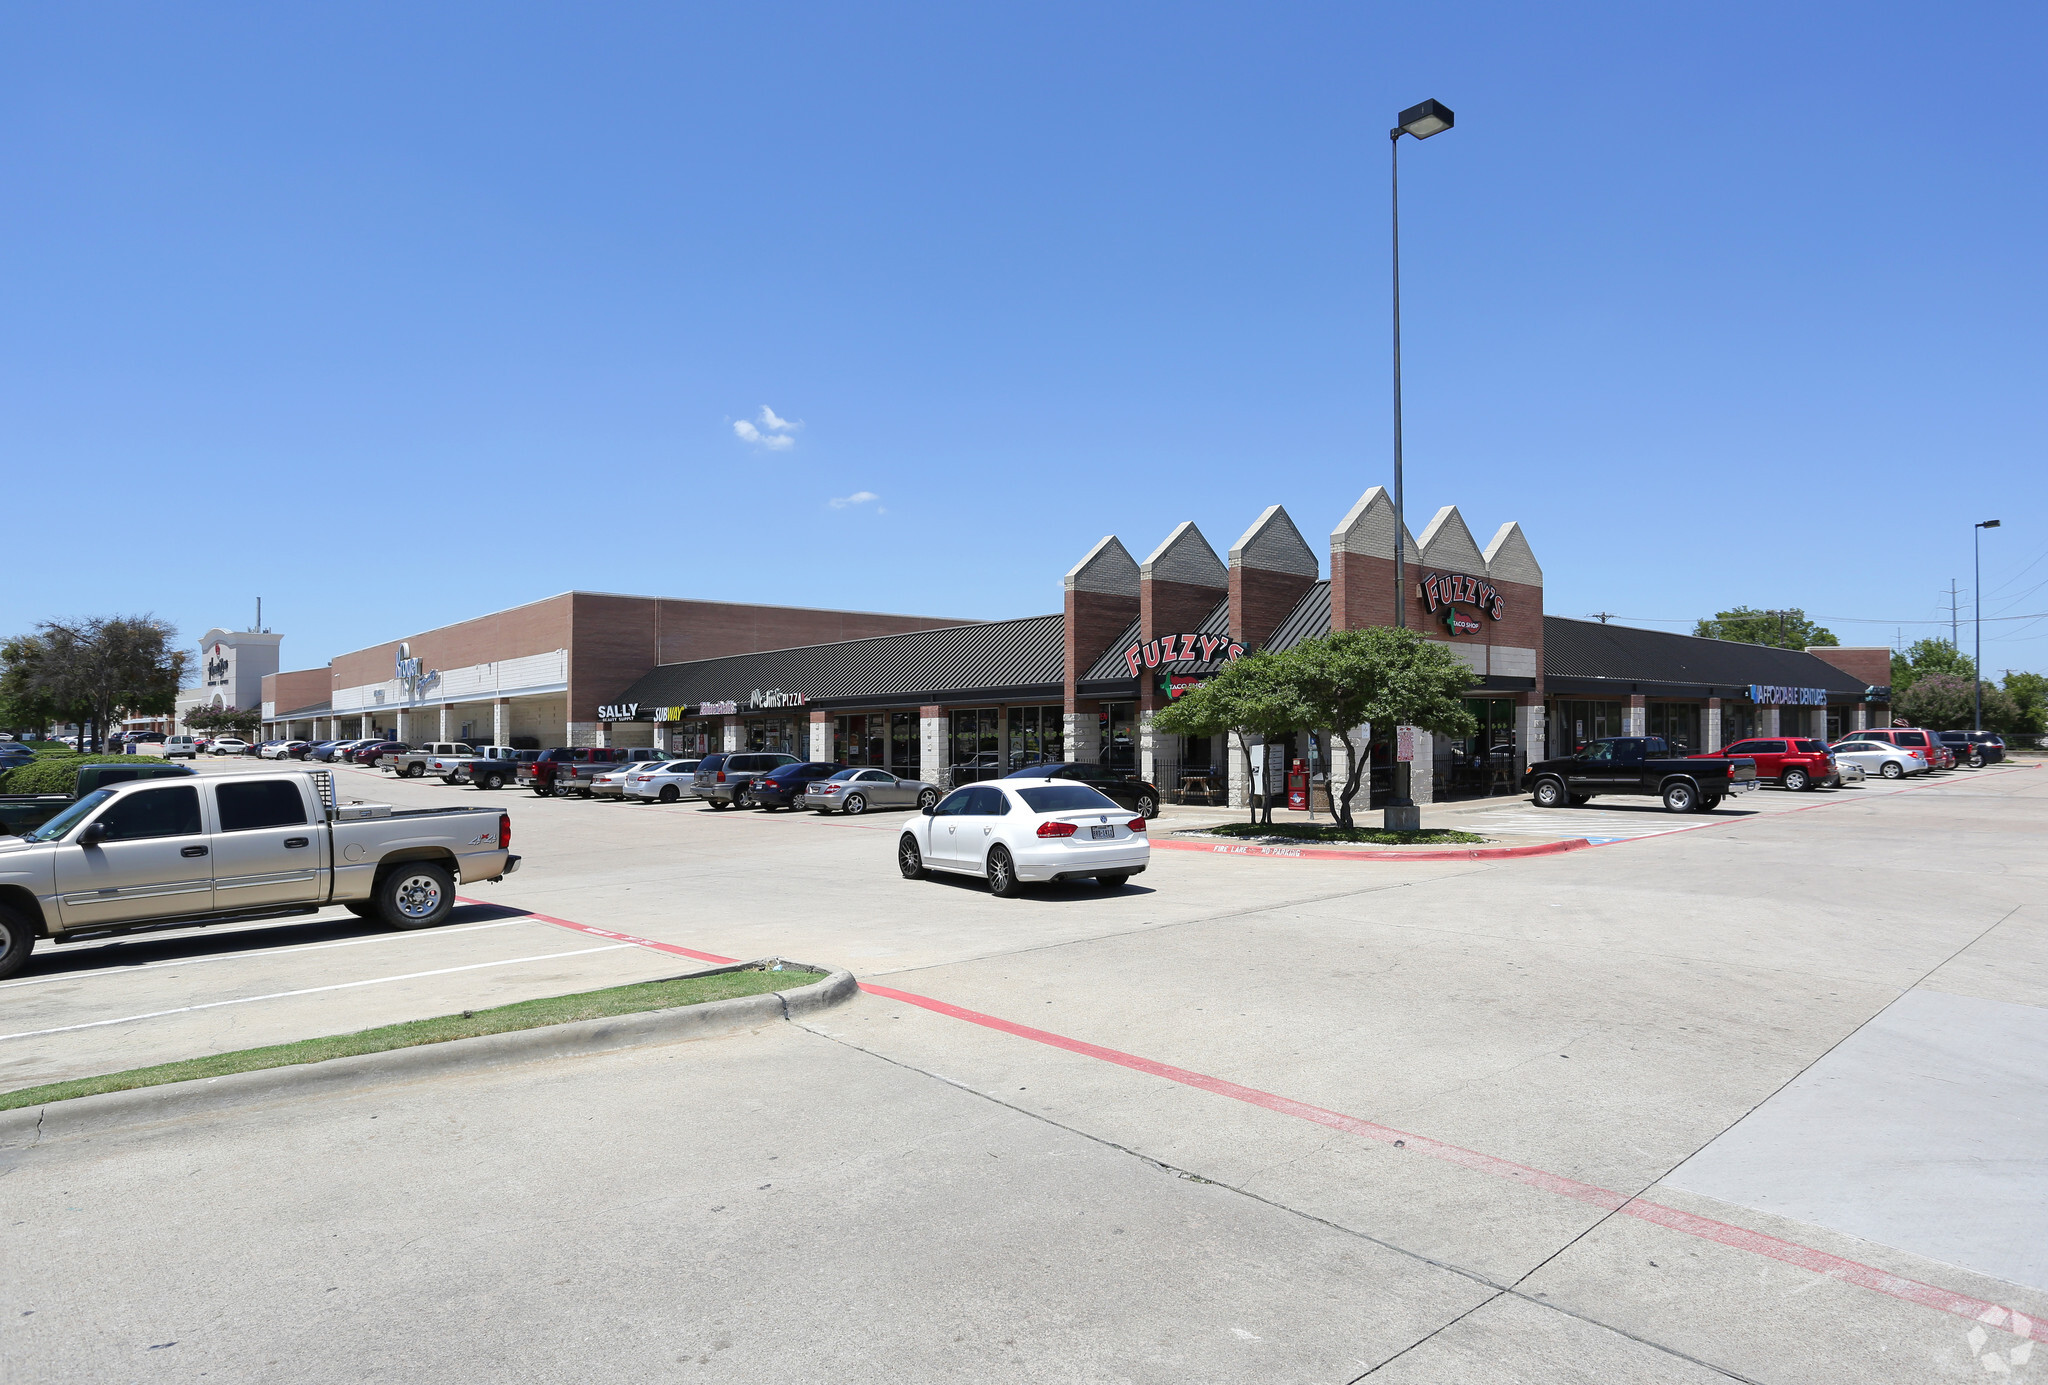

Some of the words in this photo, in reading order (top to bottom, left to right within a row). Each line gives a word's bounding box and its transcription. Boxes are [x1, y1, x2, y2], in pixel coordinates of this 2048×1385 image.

[1424, 574, 1505, 620] FUZZY'S
[1453, 620, 1466, 628] TACO
[782, 692, 803, 707] PIZZA
[1757, 685, 1798, 704] AFFORDABLE
[1800, 687, 1828, 705] DENTURES
[598, 703, 638, 718] SALLY
[654, 705, 685, 721] SUBWAY
[1261, 847, 1271, 855] NO
[1272, 848, 1301, 857] PARKING
